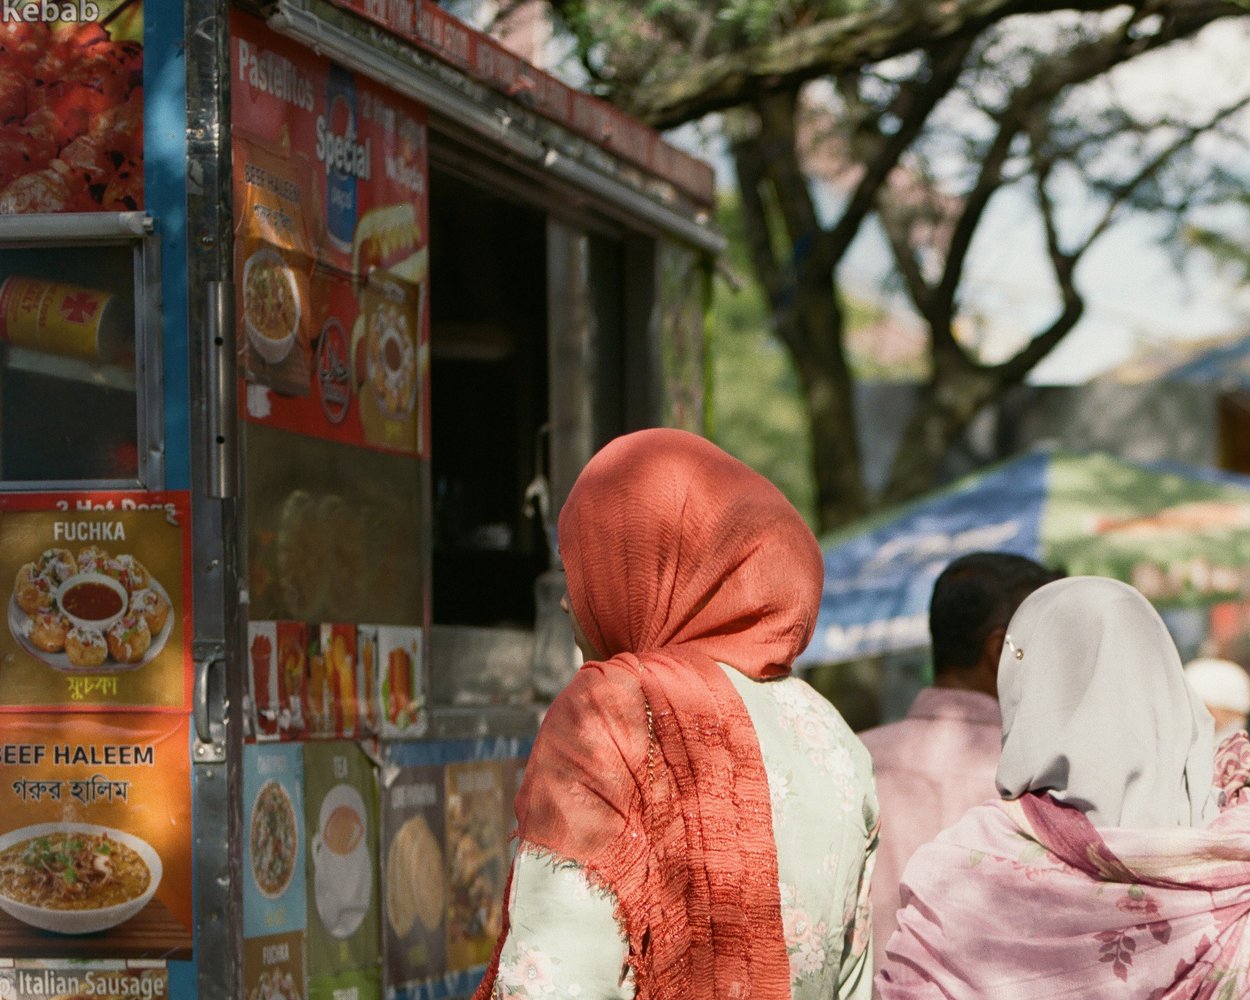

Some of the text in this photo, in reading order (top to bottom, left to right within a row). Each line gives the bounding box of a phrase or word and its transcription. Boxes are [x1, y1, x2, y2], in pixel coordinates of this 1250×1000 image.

[2, 0, 99, 22] Kebab
[238, 38, 314, 113] Pastelitos
[316, 114, 371, 181] Special
[54, 521, 126, 541] FUCHKA
[0, 745, 154, 766] EEF HALEEM
[12, 774, 129, 805] গরুর হালিম
[19, 970, 164, 1000] Italian Sausage
